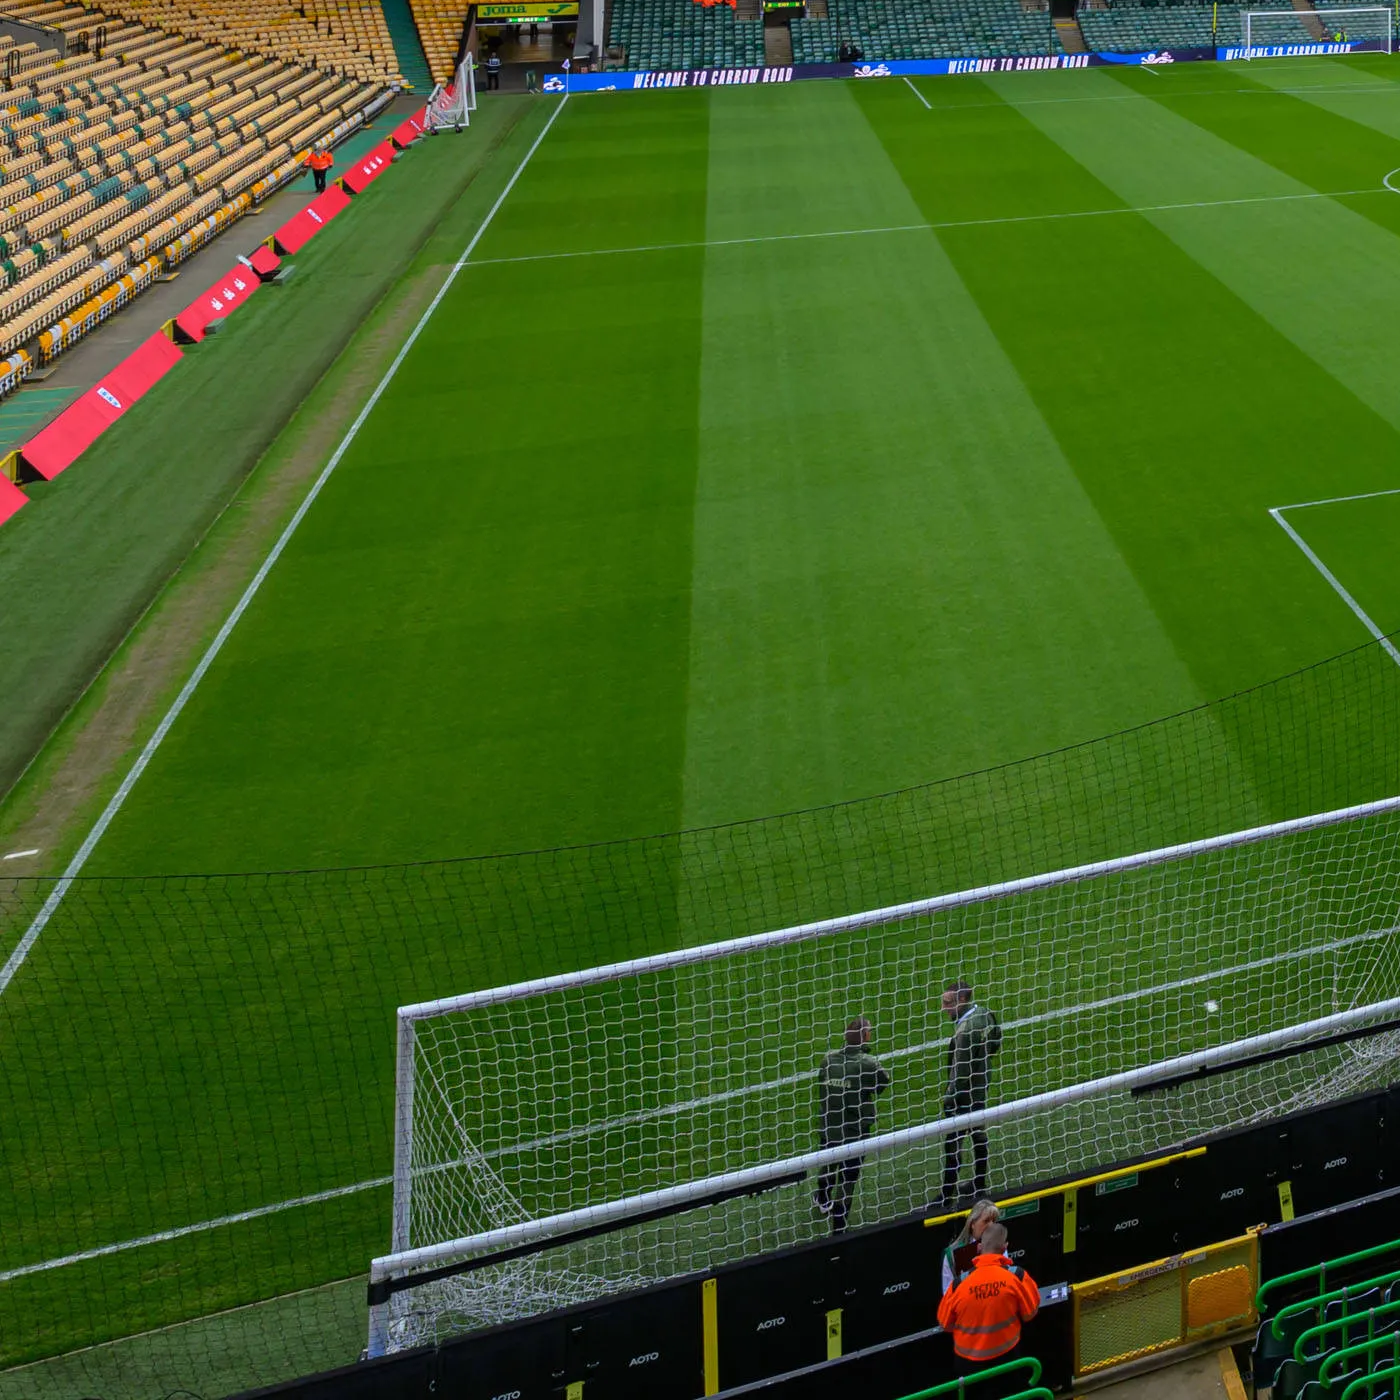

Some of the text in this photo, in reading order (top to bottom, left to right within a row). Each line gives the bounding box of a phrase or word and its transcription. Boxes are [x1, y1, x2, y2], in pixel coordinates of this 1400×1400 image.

[948, 55, 1089, 75] WELCOME TO CARROW ROAD
[633, 67, 794, 89] WELCOME TO CARROW ROAD
[1324, 1157, 1347, 1169] AOTO
[1221, 1188, 1244, 1200] AOTO
[1114, 1219, 1139, 1231] AOTO
[1130, 1257, 1195, 1281] EMERGENCY EXIT
[883, 1282, 910, 1295] AOTO
[968, 1280, 1007, 1294] SECTION
[975, 1288, 1000, 1300] HEAD
[757, 1317, 785, 1331] AOTO
[629, 1352, 659, 1367] AOTO
